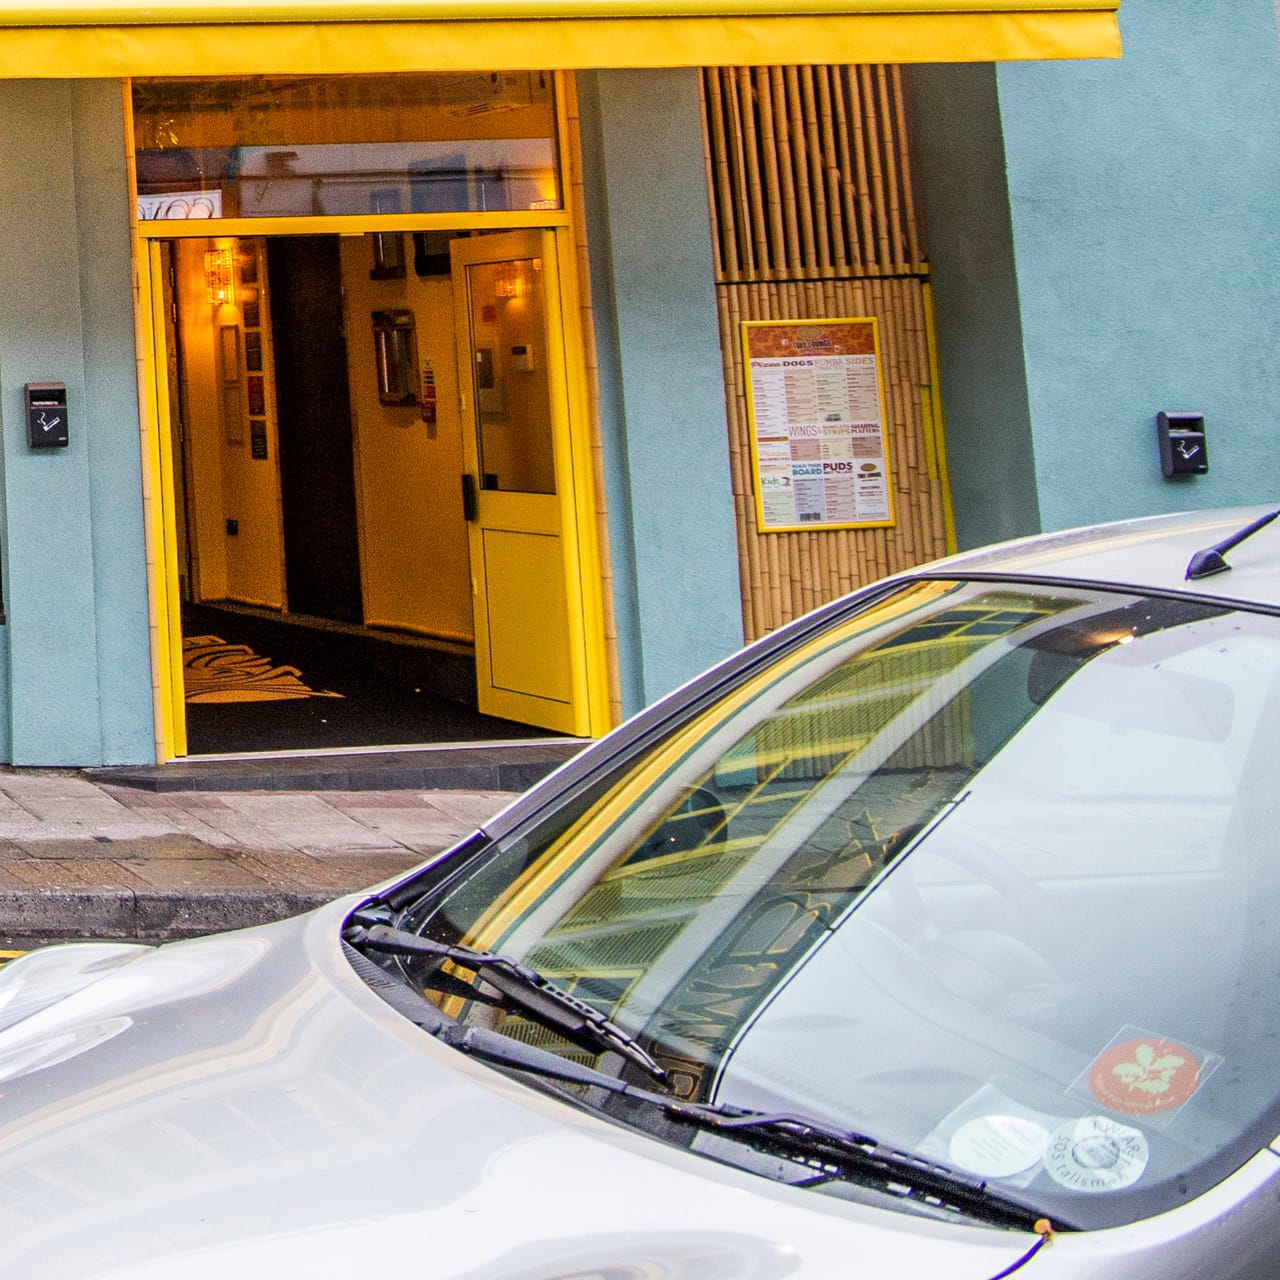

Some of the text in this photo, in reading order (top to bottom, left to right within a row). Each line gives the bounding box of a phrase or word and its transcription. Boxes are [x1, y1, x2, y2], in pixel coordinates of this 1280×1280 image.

[846, 356, 875, 365] SIDES
[788, 424, 818, 438] WINGS
[792, 468, 823, 476] BOARD
[823, 462, 854, 472] PUDS
[1051, 1135, 1070, 1161] SOS
